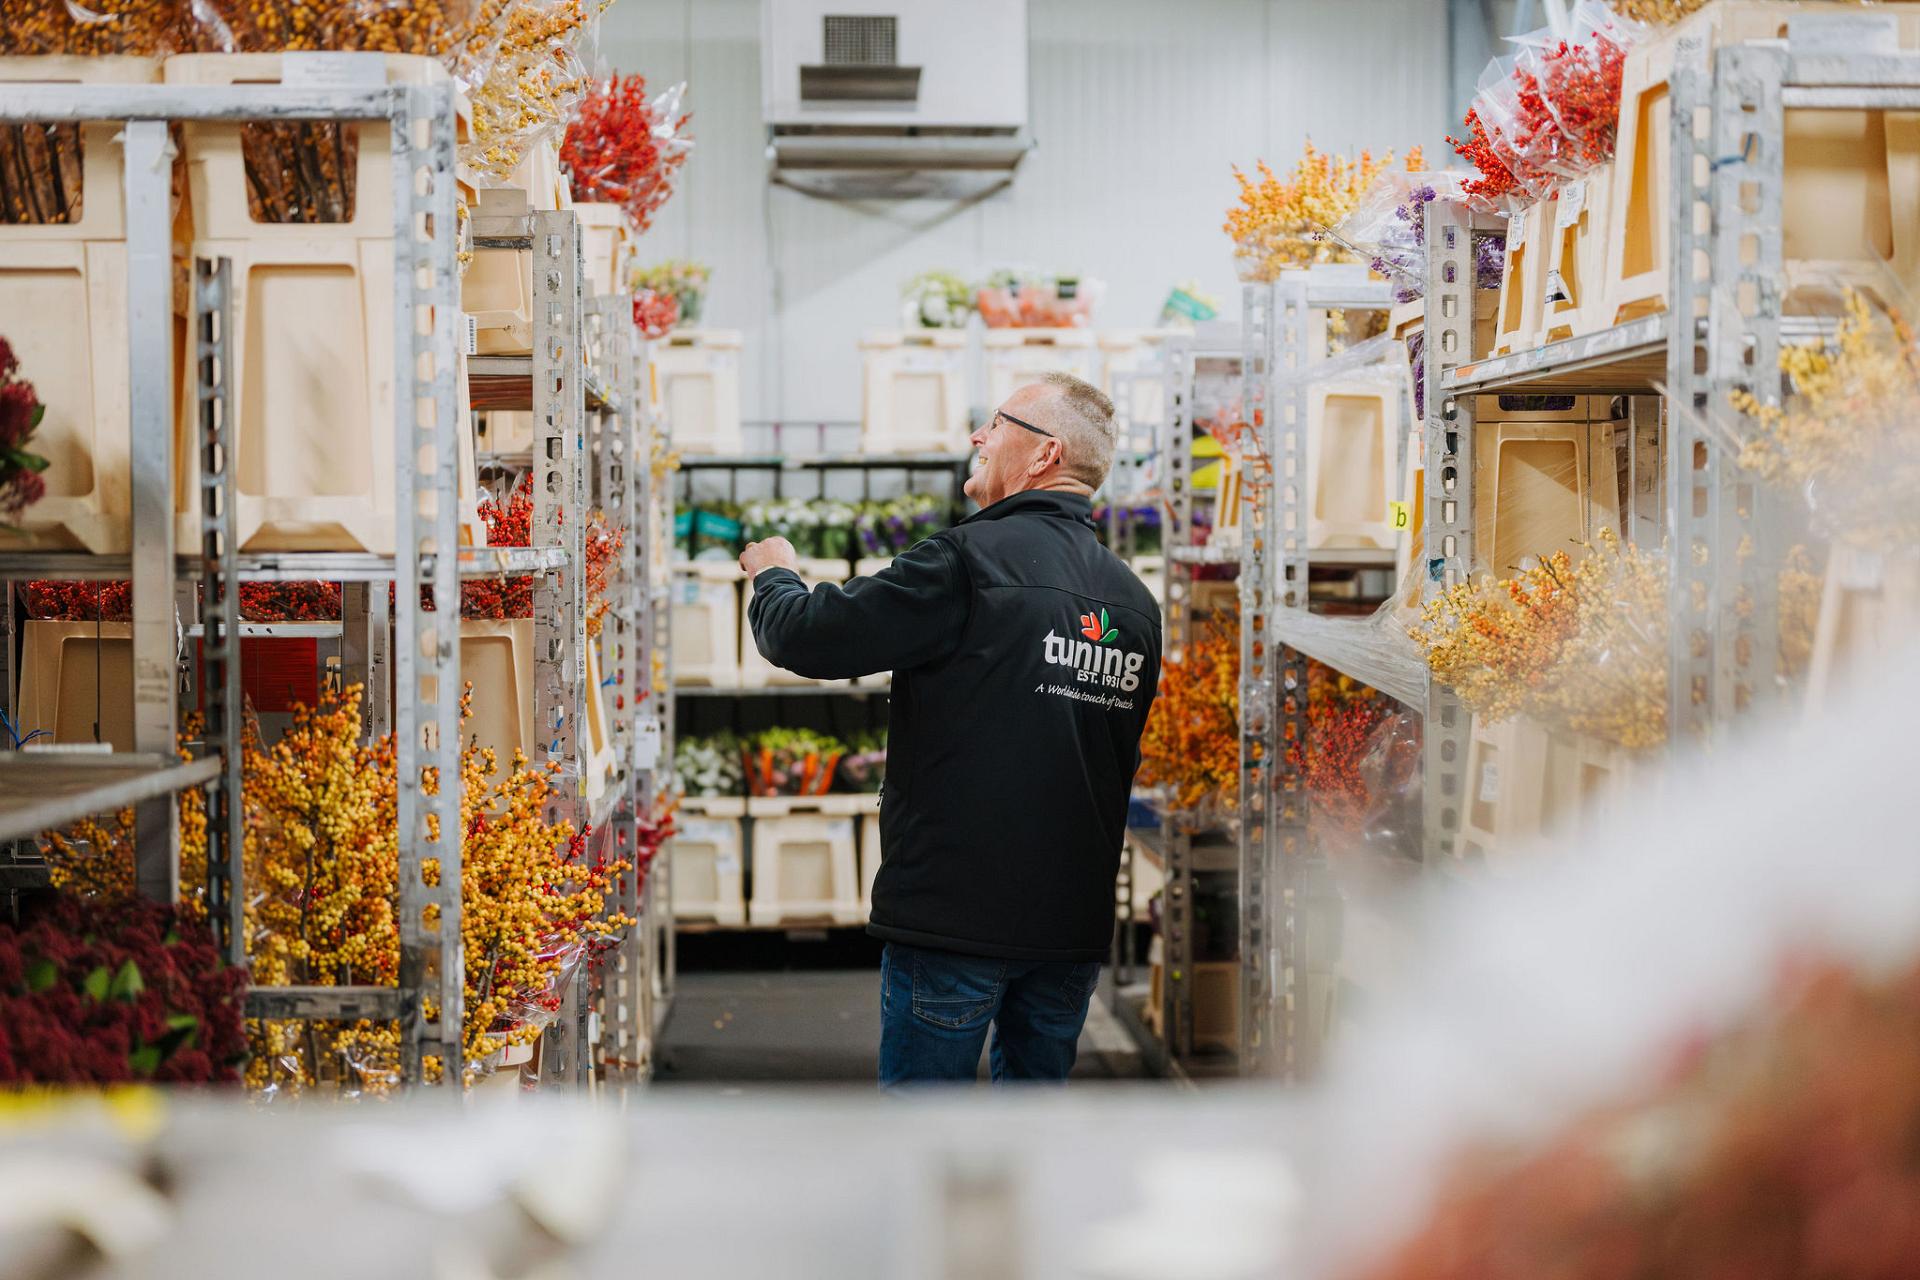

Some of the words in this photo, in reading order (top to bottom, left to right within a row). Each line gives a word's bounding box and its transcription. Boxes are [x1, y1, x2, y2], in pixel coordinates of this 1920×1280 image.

[1043, 628, 1145, 692] tuning
[1077, 669, 1098, 684] EST.
[1101, 674, 1120, 688] 1931
[1035, 683, 1045, 693] A
[1081, 691, 1106, 705] touch
[1106, 695, 1117, 711] of
[1114, 697, 1134, 710] Dutch
